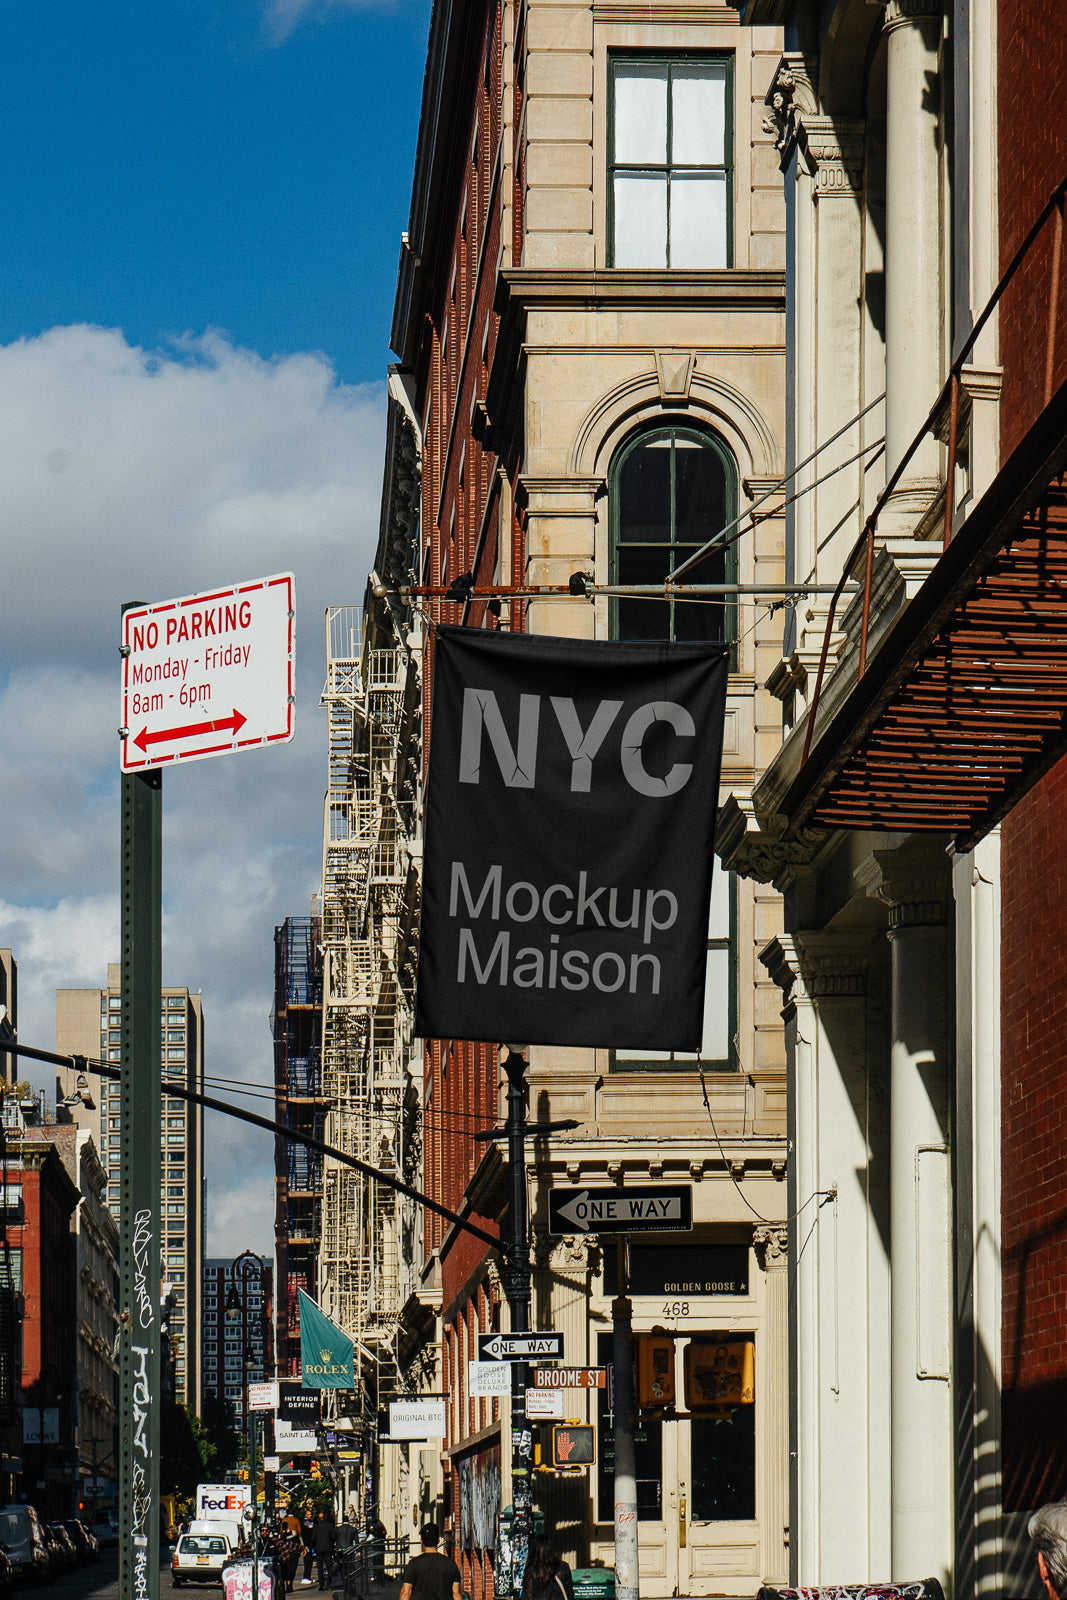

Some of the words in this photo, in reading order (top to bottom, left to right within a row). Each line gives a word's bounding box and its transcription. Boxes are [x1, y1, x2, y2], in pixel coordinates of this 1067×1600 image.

[133, 622, 159, 653] NO
[166, 601, 252, 645] PARKING
[132, 657, 189, 686] Monday
[205, 643, 251, 671] Friday
[132, 693, 163, 715] 8am
[179, 683, 212, 708] 6pm
[458, 687, 696, 798] NYC
[448, 861, 679, 944] Mockup
[456, 928, 662, 995] Maison
[575, 1201, 618, 1220] ONE
[629, 1199, 672, 1218] WAY
[664, 1282, 701, 1292] GOLDEN
[705, 1281, 736, 1291] GOOSE
[662, 1301, 690, 1316] 468
[491, 1342, 516, 1353] ONE
[527, 1340, 553, 1352] WAY
[305, 1364, 349, 1374] ROLEX
[536, 1370, 582, 1386] BROOME
[587, 1369, 601, 1386] ST
[393, 1414, 427, 1422] ORIGINAL
[428, 1413, 442, 1421] BTC
[201, 1495, 246, 1510] FedEx
